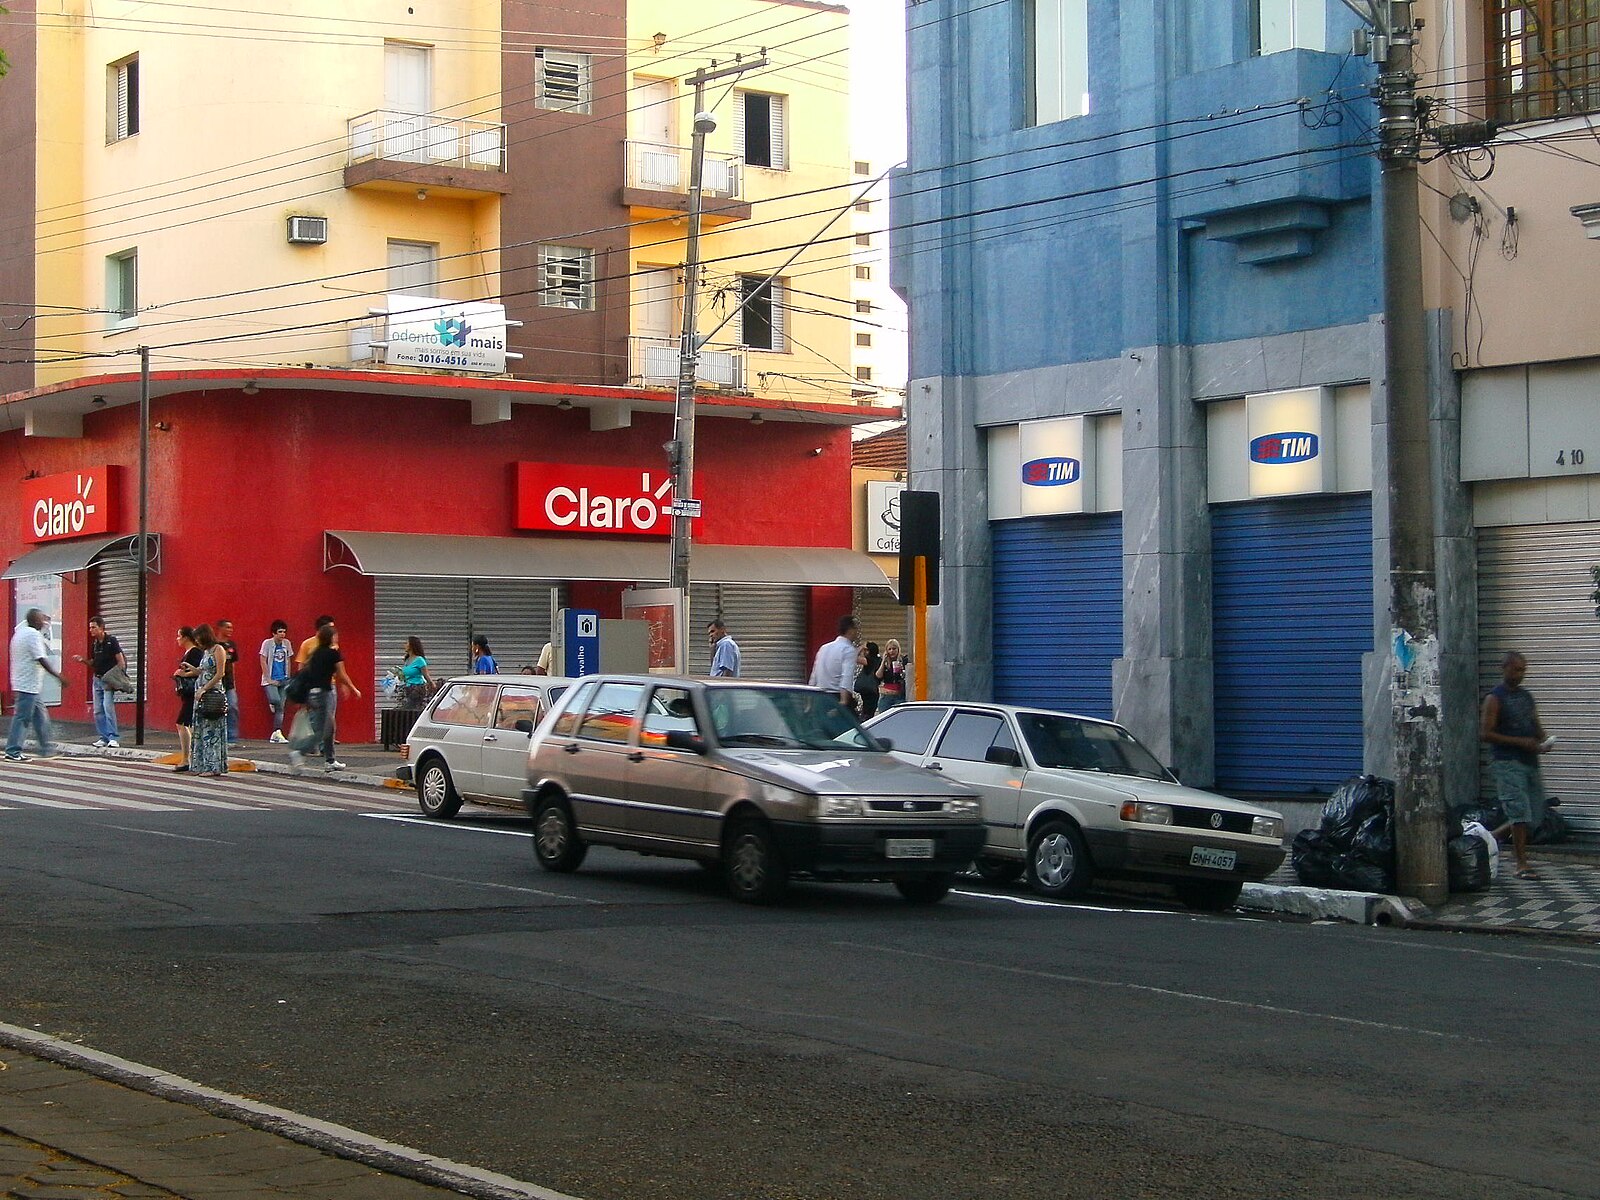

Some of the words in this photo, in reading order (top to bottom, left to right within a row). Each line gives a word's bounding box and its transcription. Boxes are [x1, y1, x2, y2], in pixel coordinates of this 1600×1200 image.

[392, 329, 438, 345] odonto
[470, 336, 503, 350] mais
[397, 353, 416, 361] Fone:
[418, 353, 467, 366] 3016-4516
[1280, 436, 1312, 459] TIM
[1047, 461, 1074, 480] TIM
[33, 497, 85, 538] Claro
[544, 486, 658, 530] Claro
